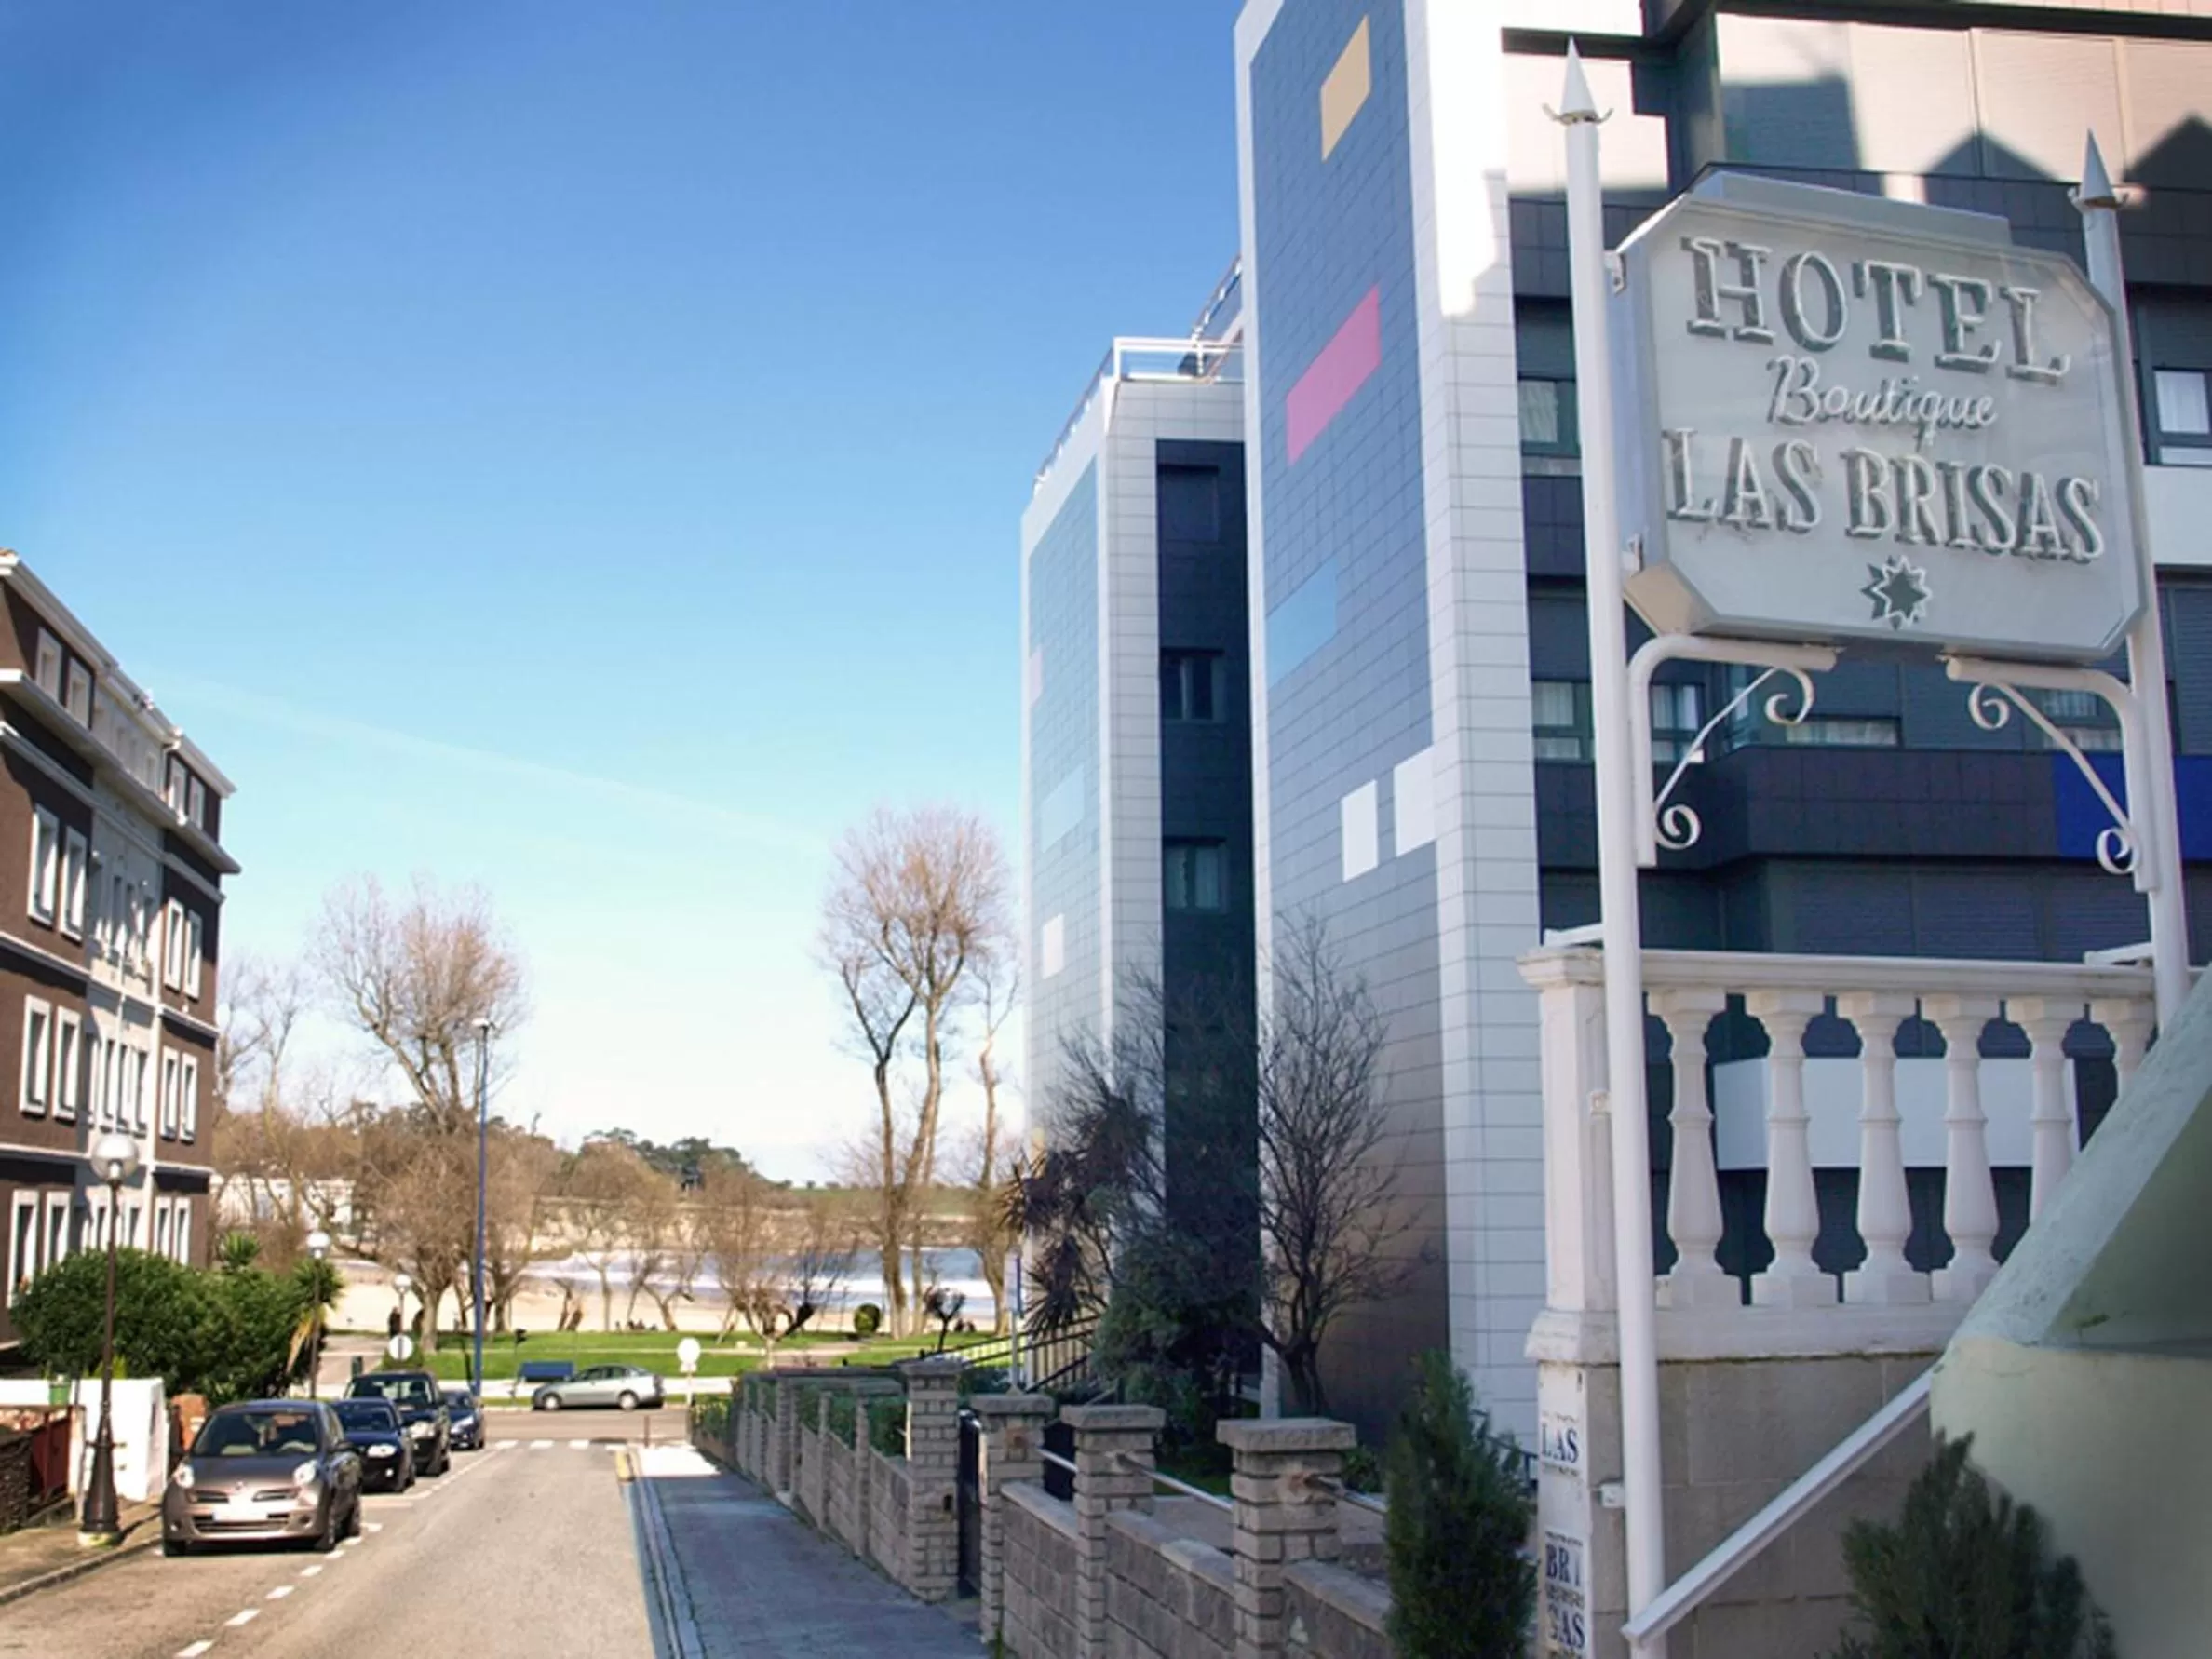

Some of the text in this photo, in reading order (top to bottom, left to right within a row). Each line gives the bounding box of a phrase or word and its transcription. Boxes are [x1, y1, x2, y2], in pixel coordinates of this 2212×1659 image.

[1681, 236, 2071, 384] HOTEL
[1767, 355, 1999, 447] Boutique
[1663, 427, 2105, 563] LAS BRISAS
[1541, 1423, 1580, 1464] LAS
